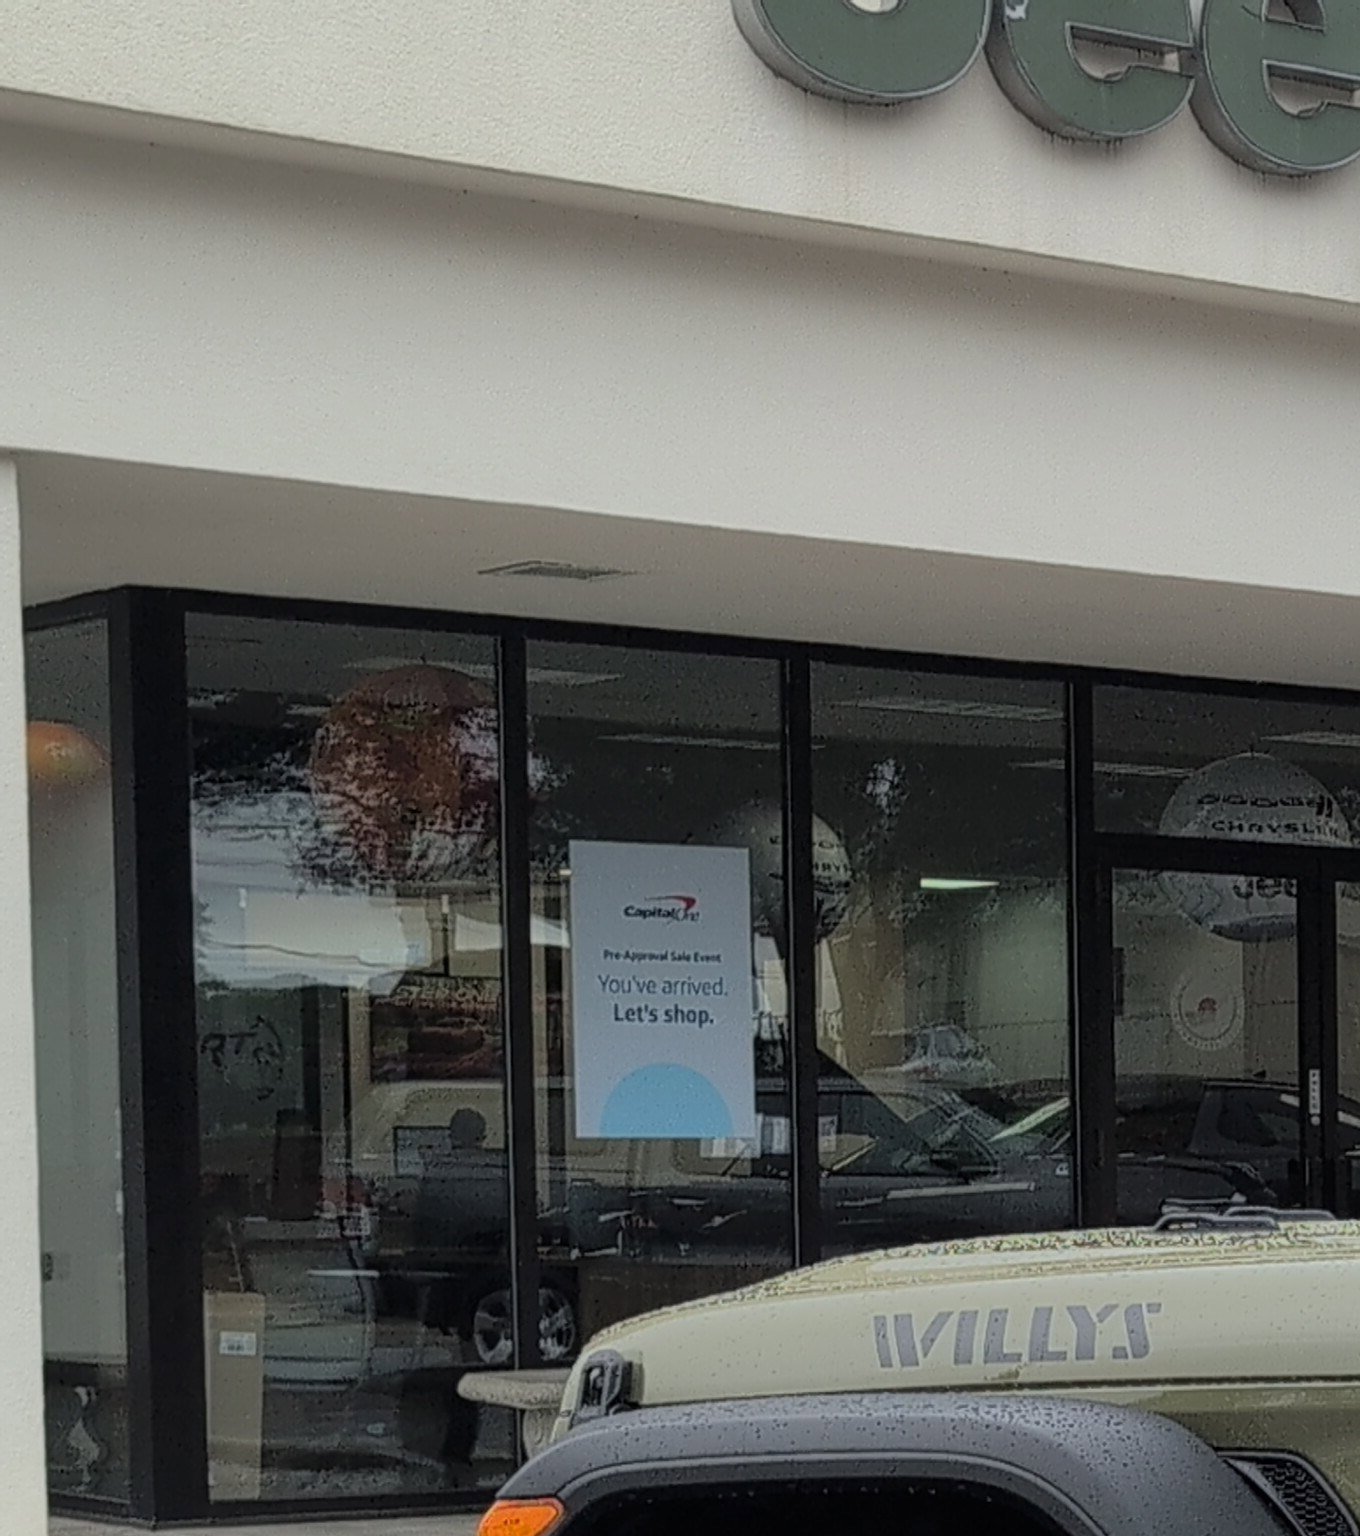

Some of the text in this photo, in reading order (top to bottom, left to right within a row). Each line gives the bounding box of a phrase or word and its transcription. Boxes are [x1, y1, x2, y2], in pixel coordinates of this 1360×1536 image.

[603, 949, 721, 963] Pre-Approval Sale Event
[598, 974, 728, 996] You've arrived.
[614, 1003, 714, 1028] Let's shop.
[873, 1302, 1162, 1368] WILLYS
